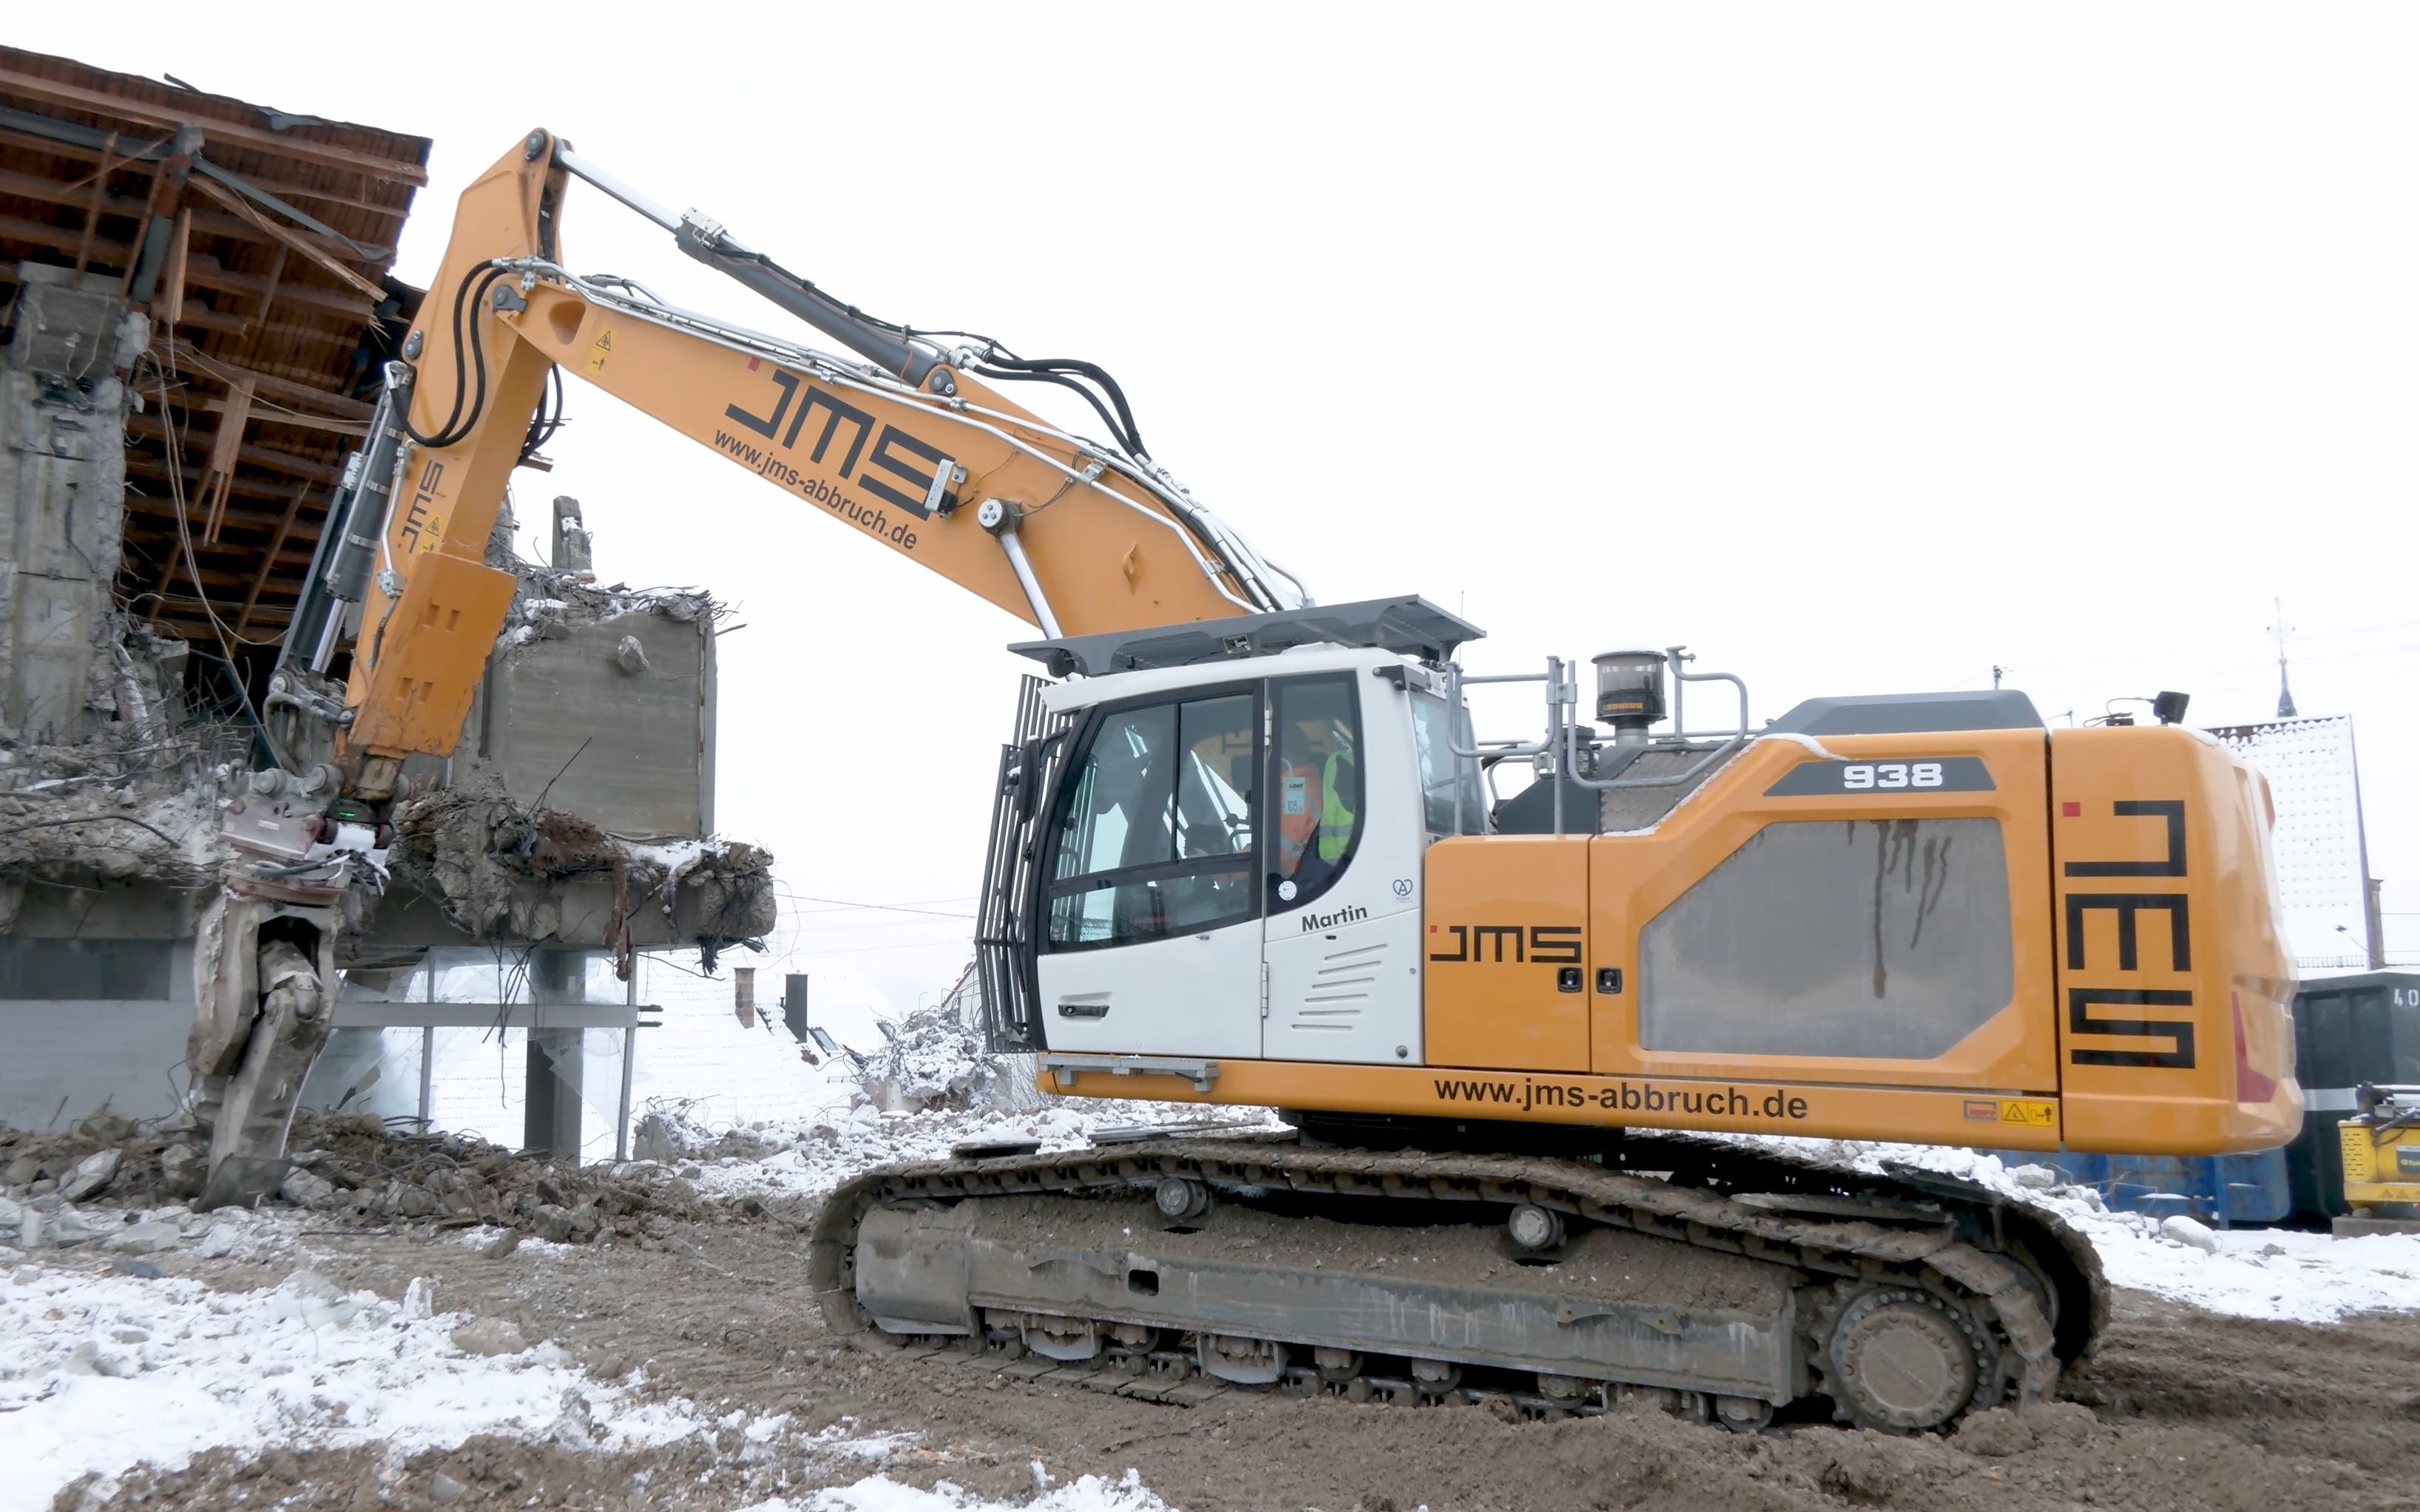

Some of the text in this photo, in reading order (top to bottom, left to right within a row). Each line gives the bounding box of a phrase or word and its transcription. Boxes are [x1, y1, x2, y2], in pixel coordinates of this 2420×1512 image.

[725, 368, 956, 521] JMS
[401, 459, 445, 554] JMS
[714, 429, 917, 550] www.jms-abbruch.de
[1844, 763, 1943, 789] 938
[1302, 905, 1368, 932] Martin
[1430, 926, 1582, 963] JMS
[2063, 799, 2196, 1069] JMS
[1434, 1077, 1808, 1119] www.jms-abbruch.de
